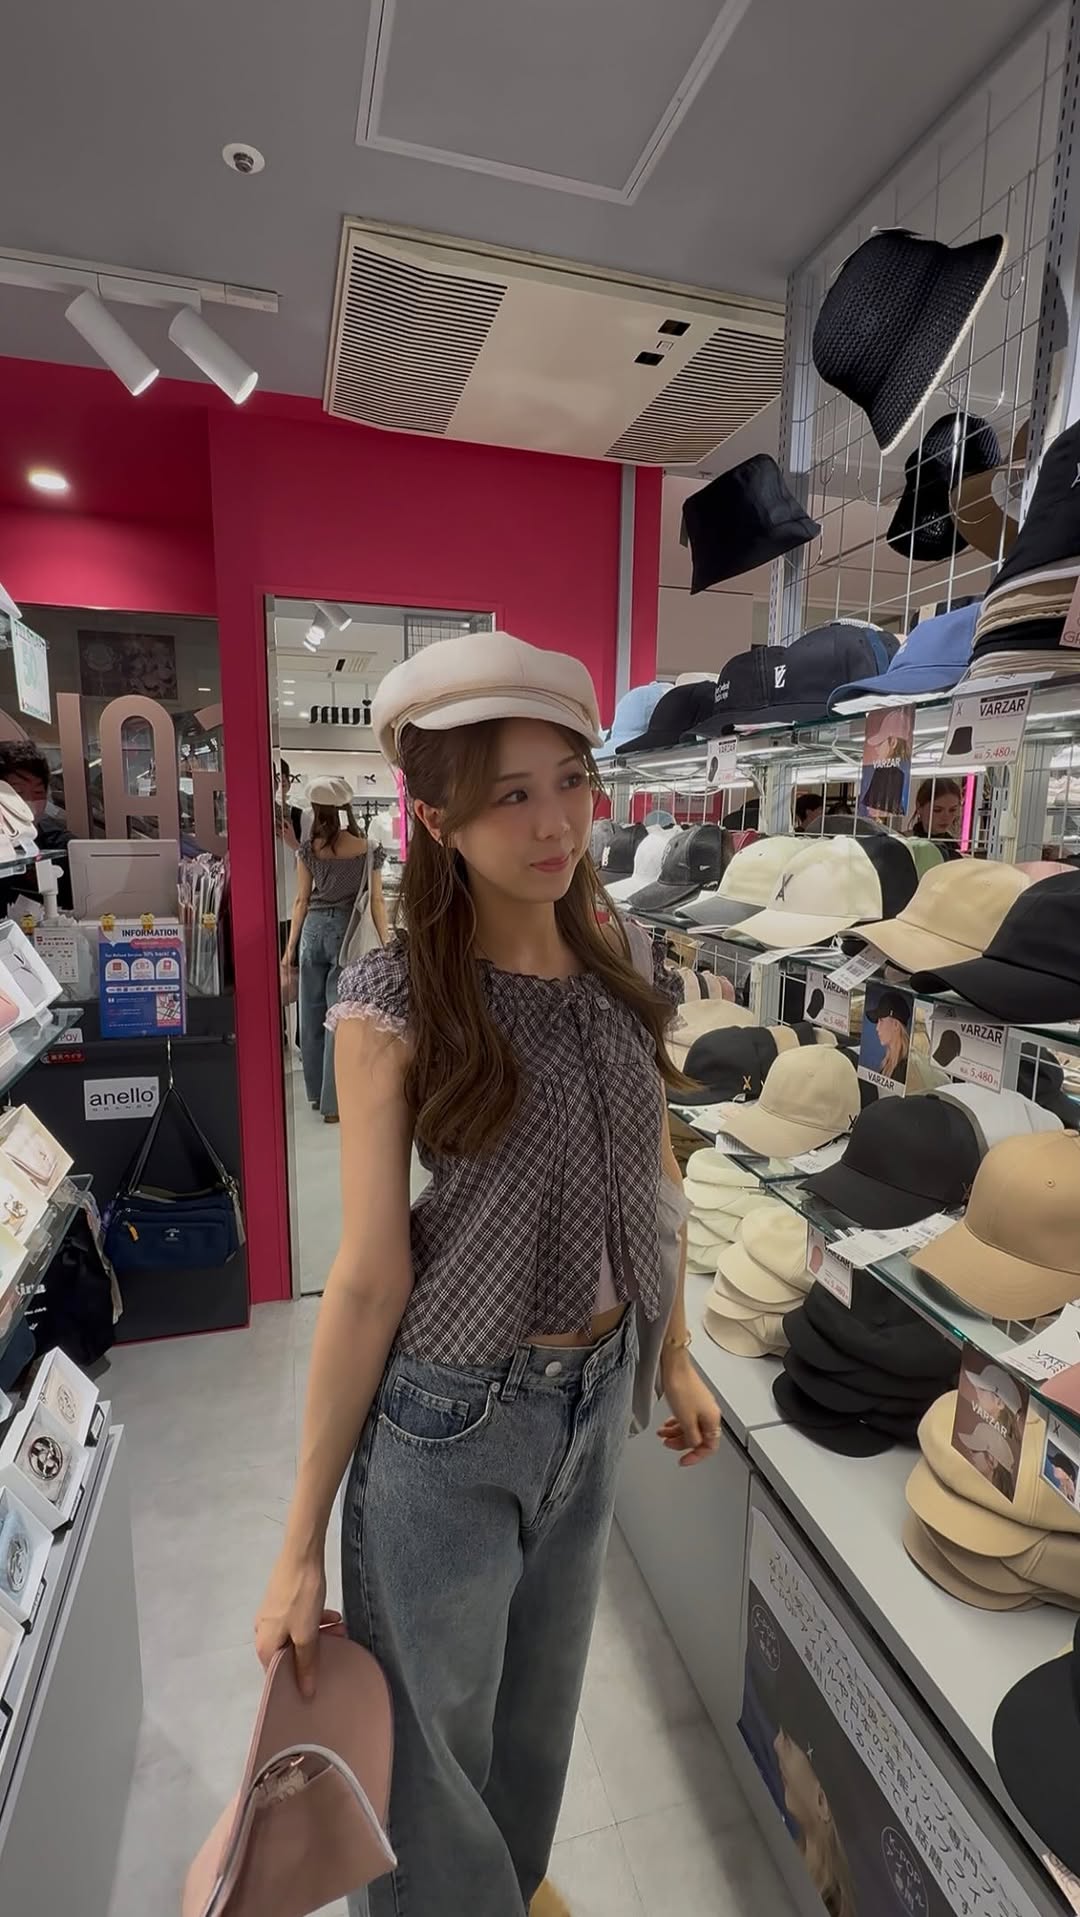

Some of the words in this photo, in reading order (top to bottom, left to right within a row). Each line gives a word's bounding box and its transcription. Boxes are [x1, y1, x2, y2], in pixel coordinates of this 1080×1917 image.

[980, 698, 1026, 717] VARZAR
[873, 757, 901, 769] VARZAR
[121, 928, 178, 937] INFORMATION
[960, 1023, 1003, 1045] VARZAR
[868, 1071, 895, 1091] VARZAR
[90, 1087, 153, 1106] anello
[971, 1400, 1008, 1437] VARZAR
